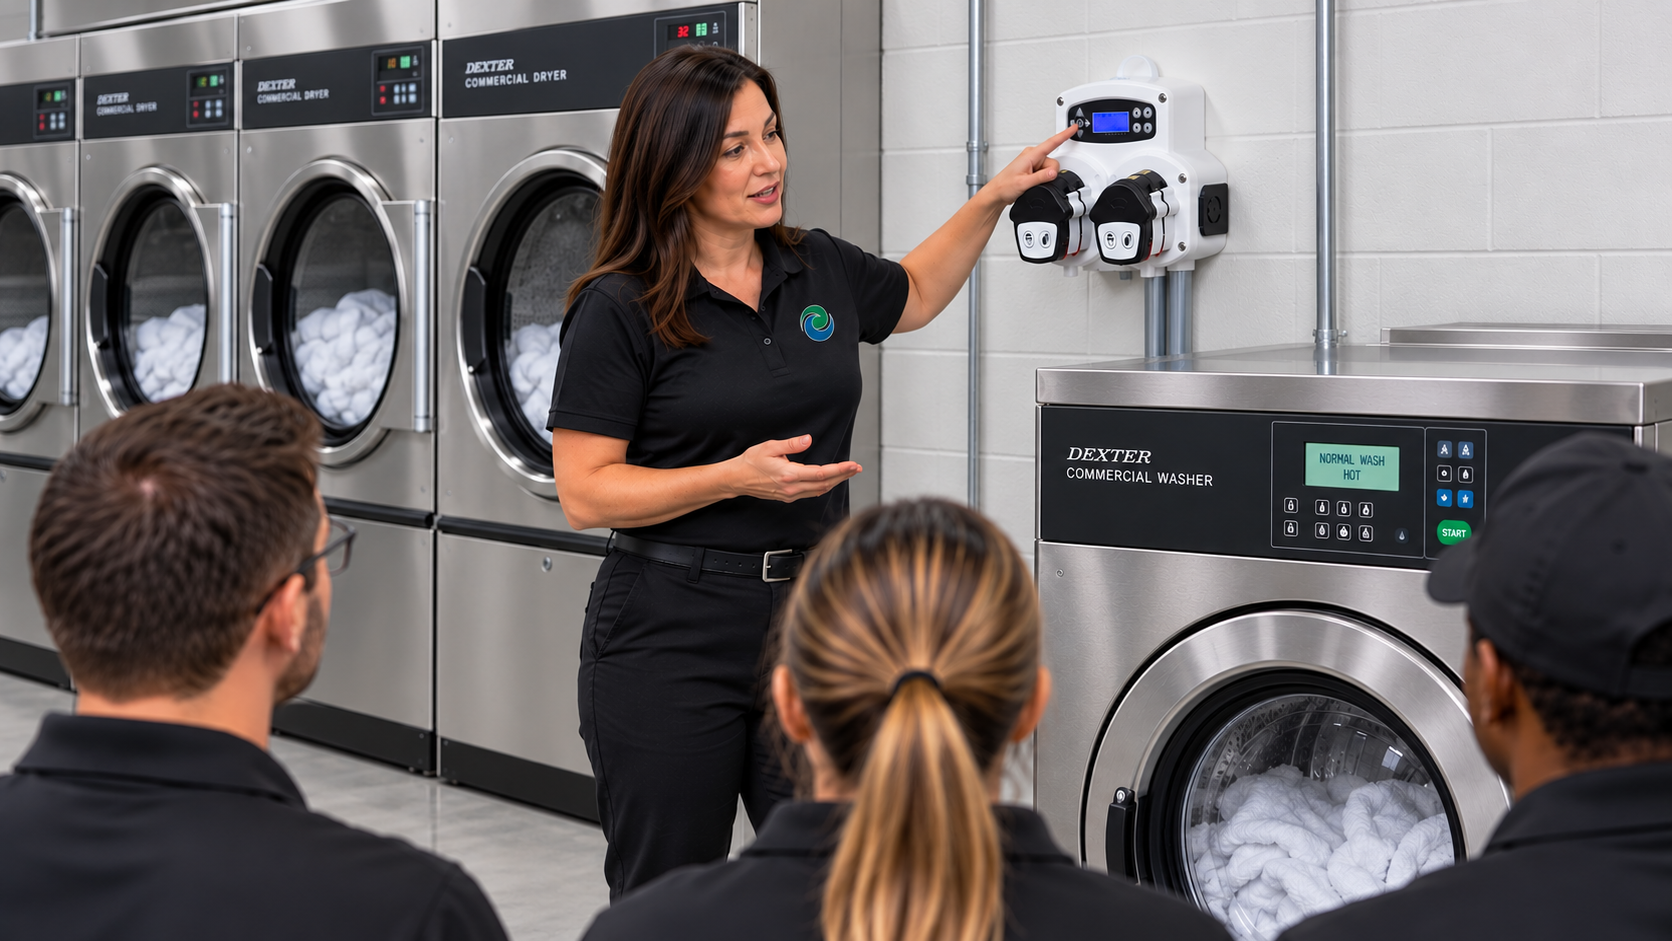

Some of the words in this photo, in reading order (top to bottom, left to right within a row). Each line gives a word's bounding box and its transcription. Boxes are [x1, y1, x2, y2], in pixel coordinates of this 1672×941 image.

[465, 58, 515, 75] DEXTER
[257, 78, 296, 92] DEXTER
[464, 73, 529, 89] COMMERCIAL
[533, 69, 567, 83] DRYER
[257, 90, 302, 104] COMMERCIAL
[304, 89, 330, 101] DRYER
[1066, 446, 1152, 464] DEXTER
[1319, 452, 1355, 466] NORMAL
[1360, 454, 1386, 467] WASH
[1066, 466, 1152, 484] COMMERCIAL
[1157, 471, 1213, 487] WASHER
[1343, 469, 1361, 481] HOT
[1442, 527, 1467, 538] START
